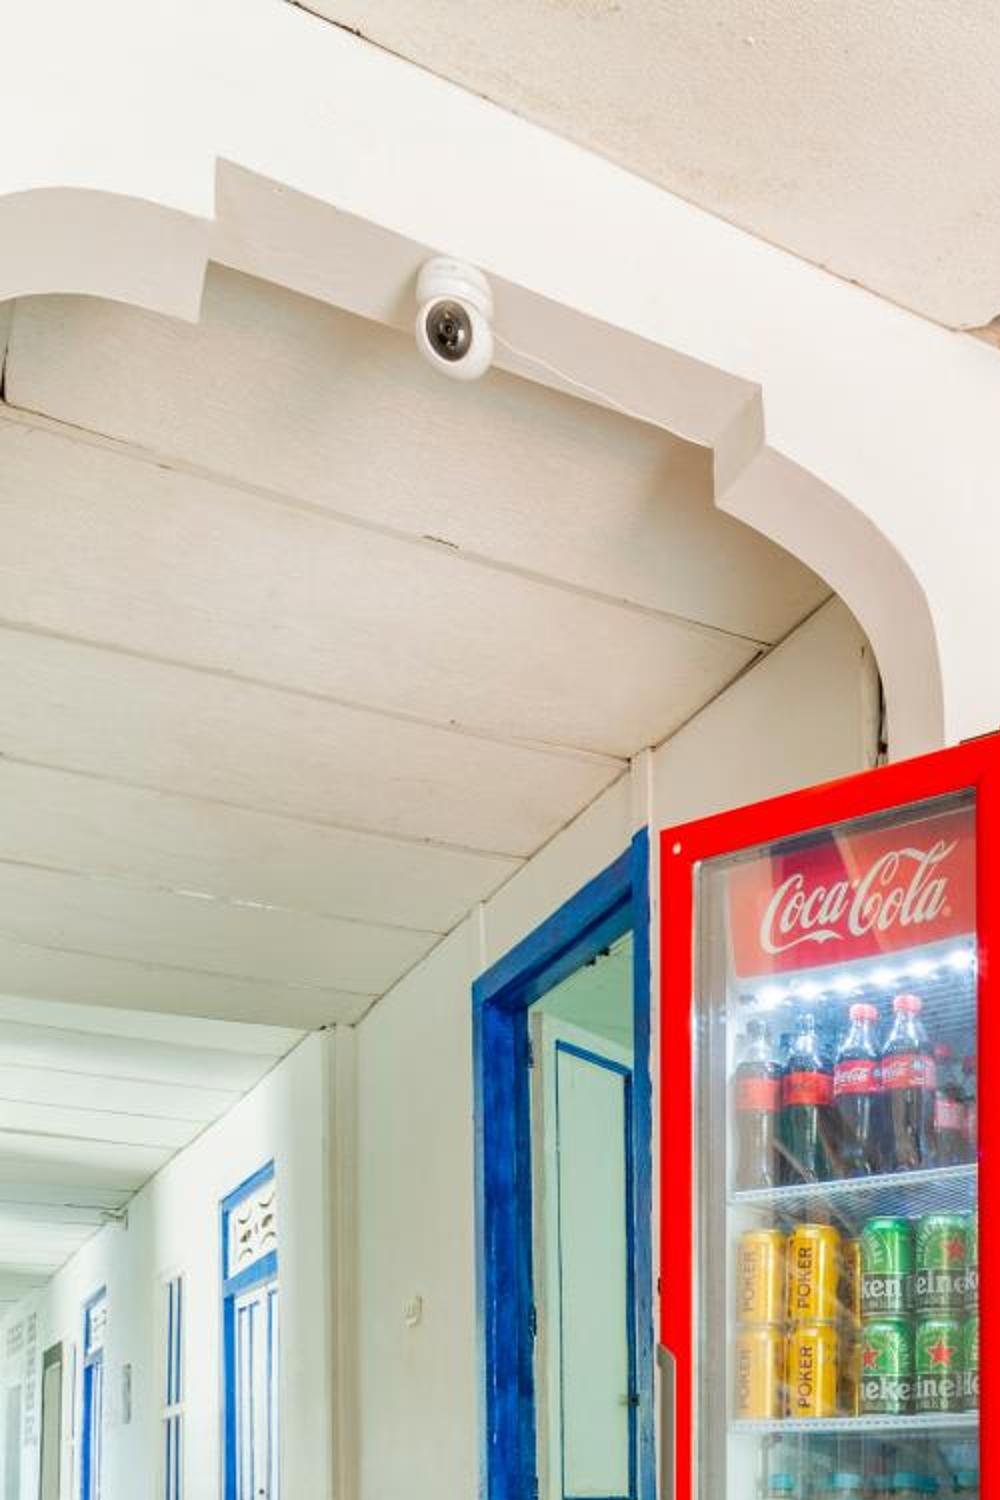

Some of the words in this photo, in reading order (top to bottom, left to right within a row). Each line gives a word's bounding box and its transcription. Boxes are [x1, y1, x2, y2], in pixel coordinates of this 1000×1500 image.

[760, 839, 961, 955] Coca-Cola
[797, 1247, 812, 1309] POKER
[798, 1346, 813, 1408] POKER
